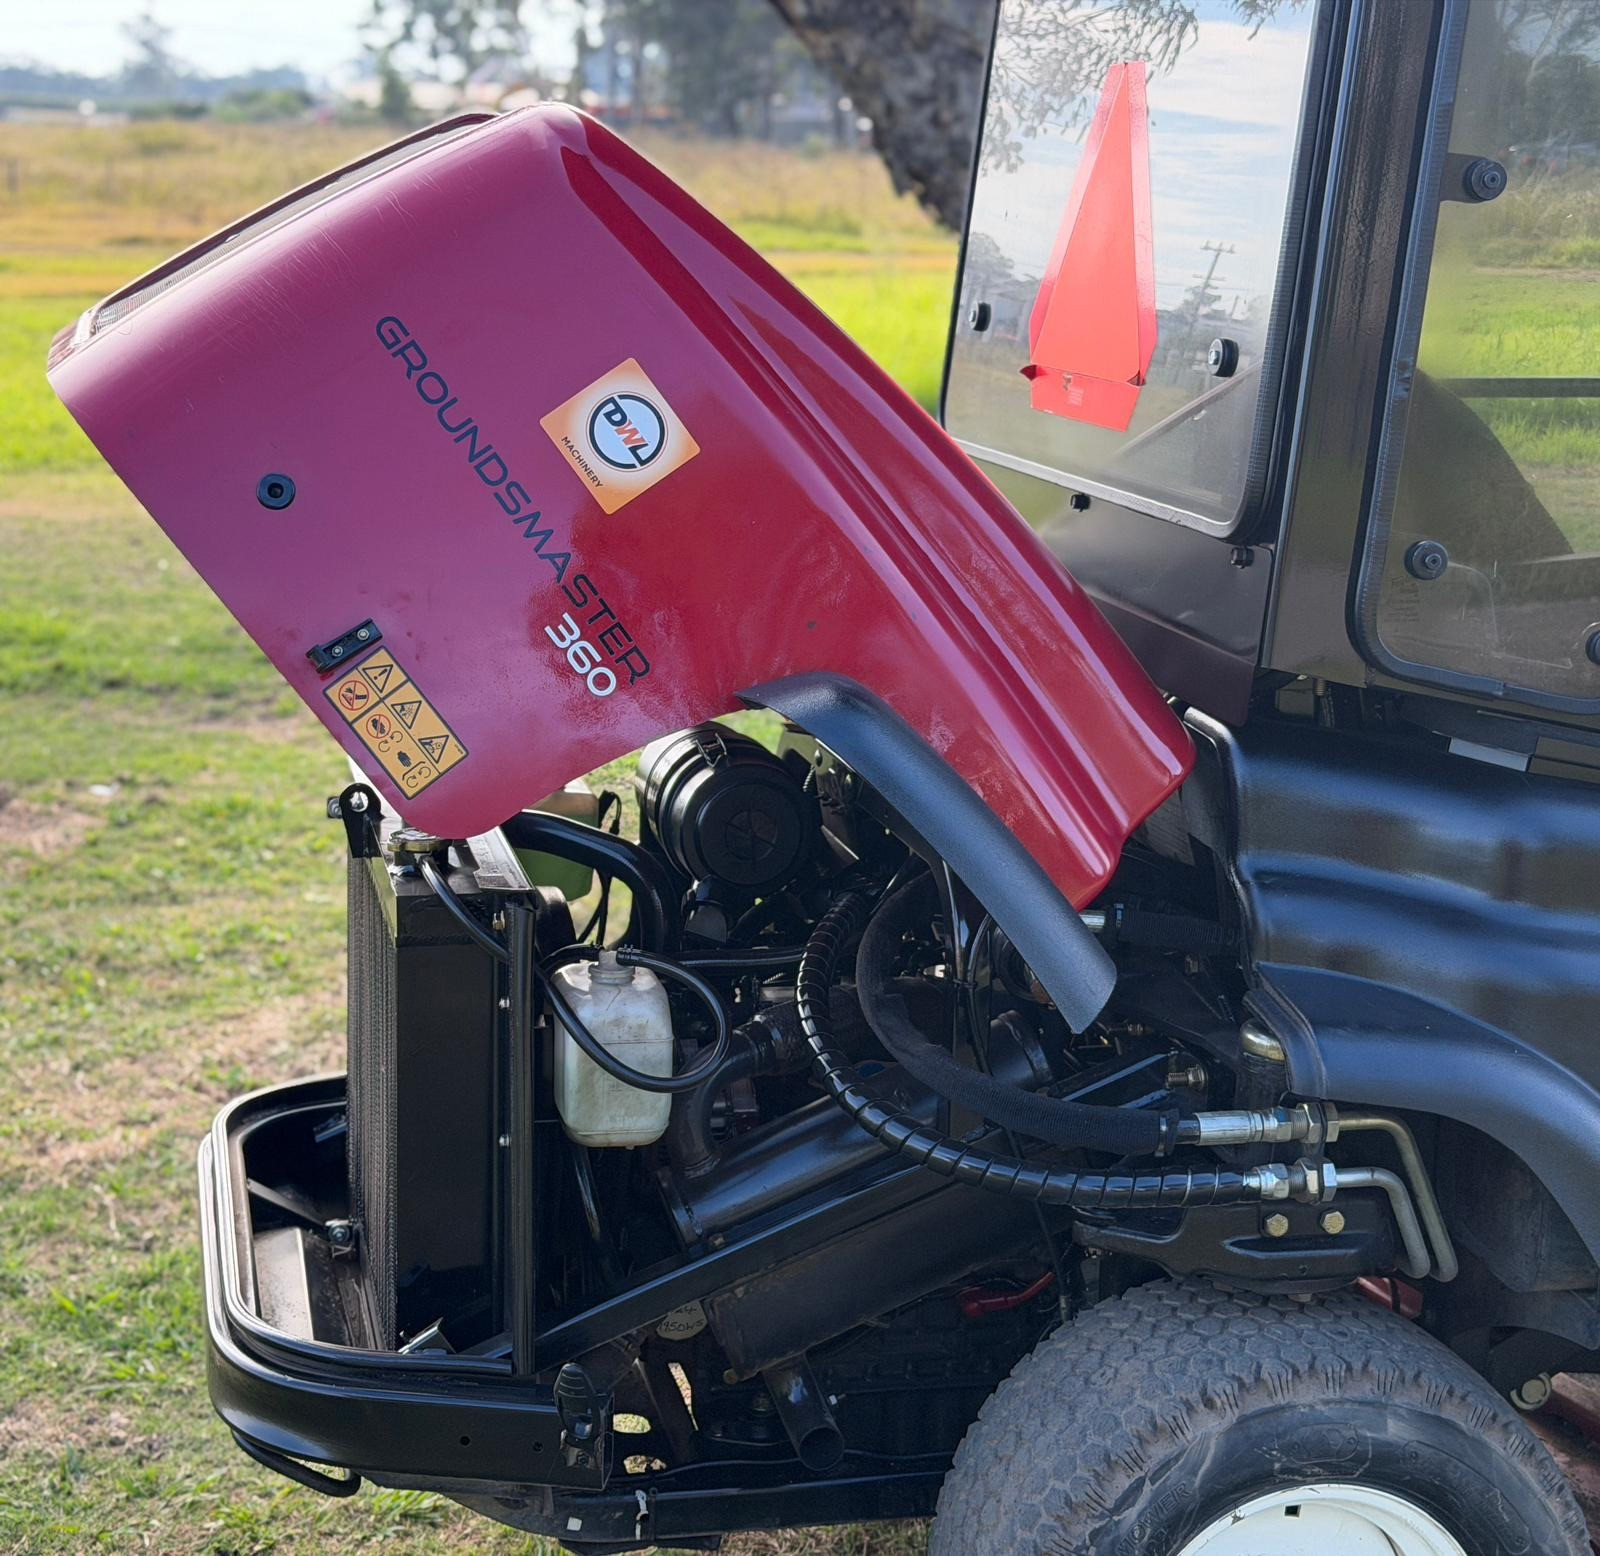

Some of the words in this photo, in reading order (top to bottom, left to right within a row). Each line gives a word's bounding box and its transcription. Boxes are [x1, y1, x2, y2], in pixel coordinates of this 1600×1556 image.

[560, 436, 604, 488] MACHINERY
[600, 397, 652, 467] DWL
[375, 315, 651, 685] GROUNDSMASTER
[544, 612, 617, 697] 360
